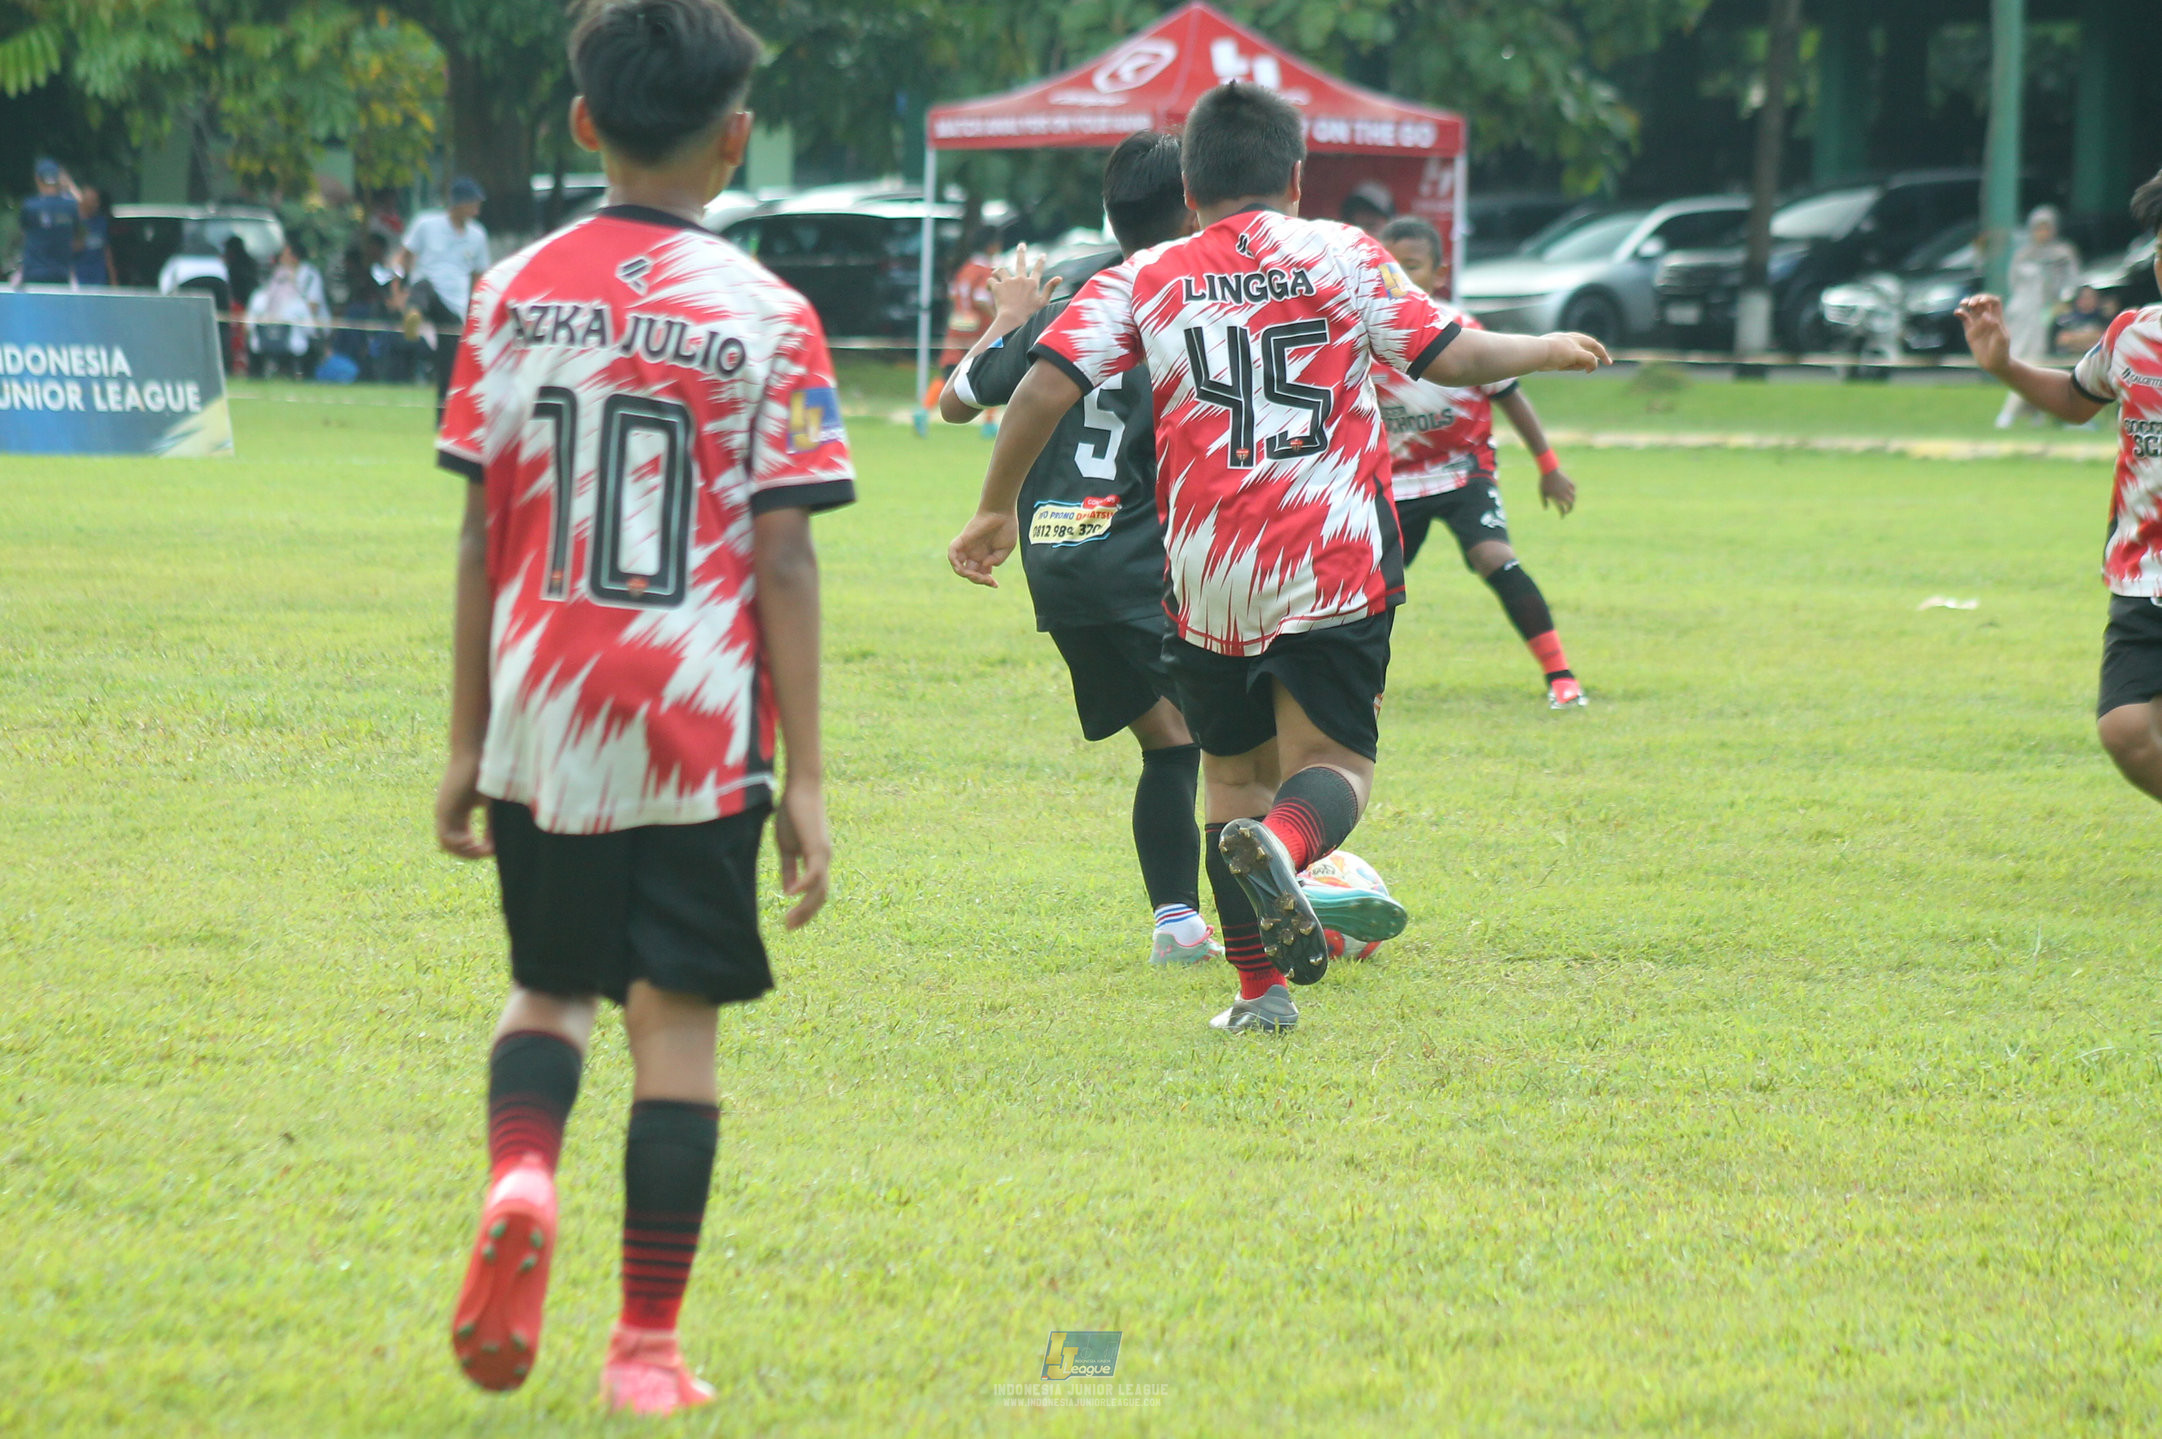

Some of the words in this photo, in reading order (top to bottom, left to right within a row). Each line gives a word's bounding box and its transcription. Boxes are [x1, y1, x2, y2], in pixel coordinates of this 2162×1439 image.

[1183, 268, 1317, 304] LINGGA
[506, 301, 612, 350] AZKA
[620, 313, 748, 379] JULIO
[93, 380, 201, 412] LEAGUE
[1074, 370, 1126, 481] 5
[1184, 318, 1334, 469] 45
[532, 386, 694, 609] 10
